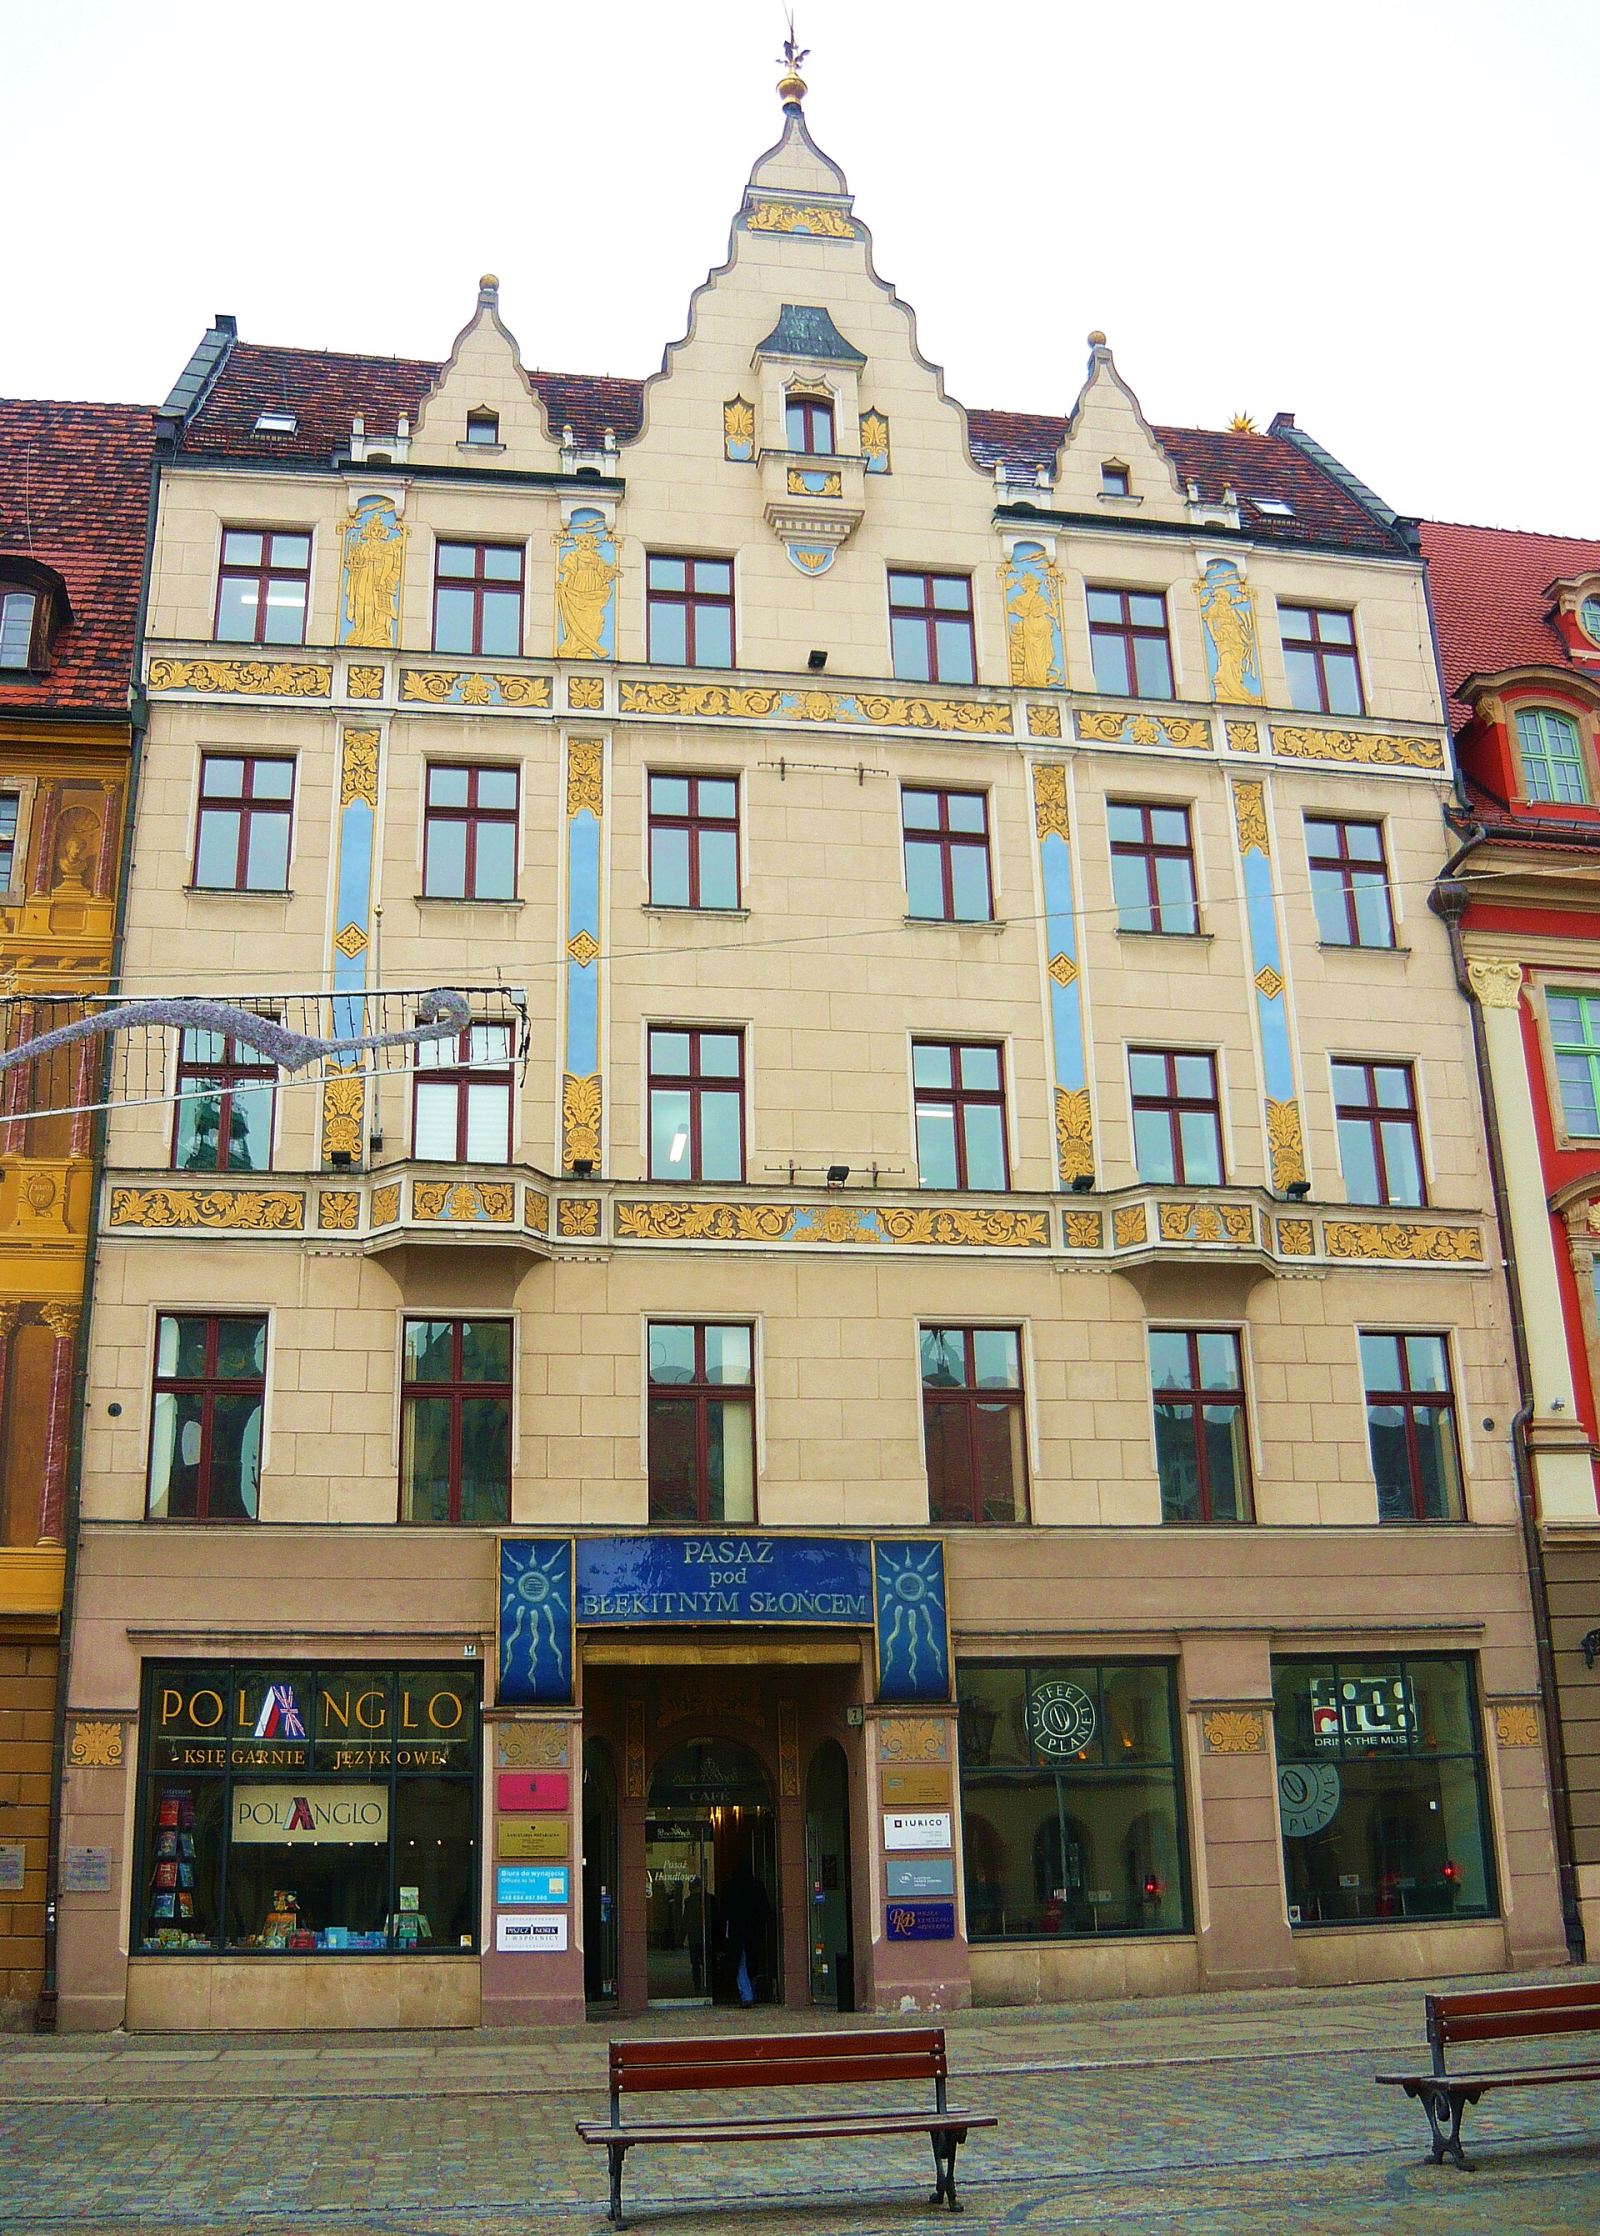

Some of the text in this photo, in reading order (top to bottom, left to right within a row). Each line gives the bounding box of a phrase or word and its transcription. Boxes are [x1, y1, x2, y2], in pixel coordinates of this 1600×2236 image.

[683, 1537, 774, 1564] PASAŻ
[709, 1567, 747, 1588] pod
[582, 1588, 866, 1617] BŁĘKITNYM SŁOŃCEM
[1033, 1686, 1074, 1728] COFFEE
[1047, 1704, 1092, 1752] PLANET
[1354, 1736, 1377, 1746] THE
[1380, 1735, 1419, 1745] MUSC
[184, 1748, 443, 1771] KSIĘGARNIE JĘZYKOWE
[238, 1796, 383, 1832] POLANGLO
